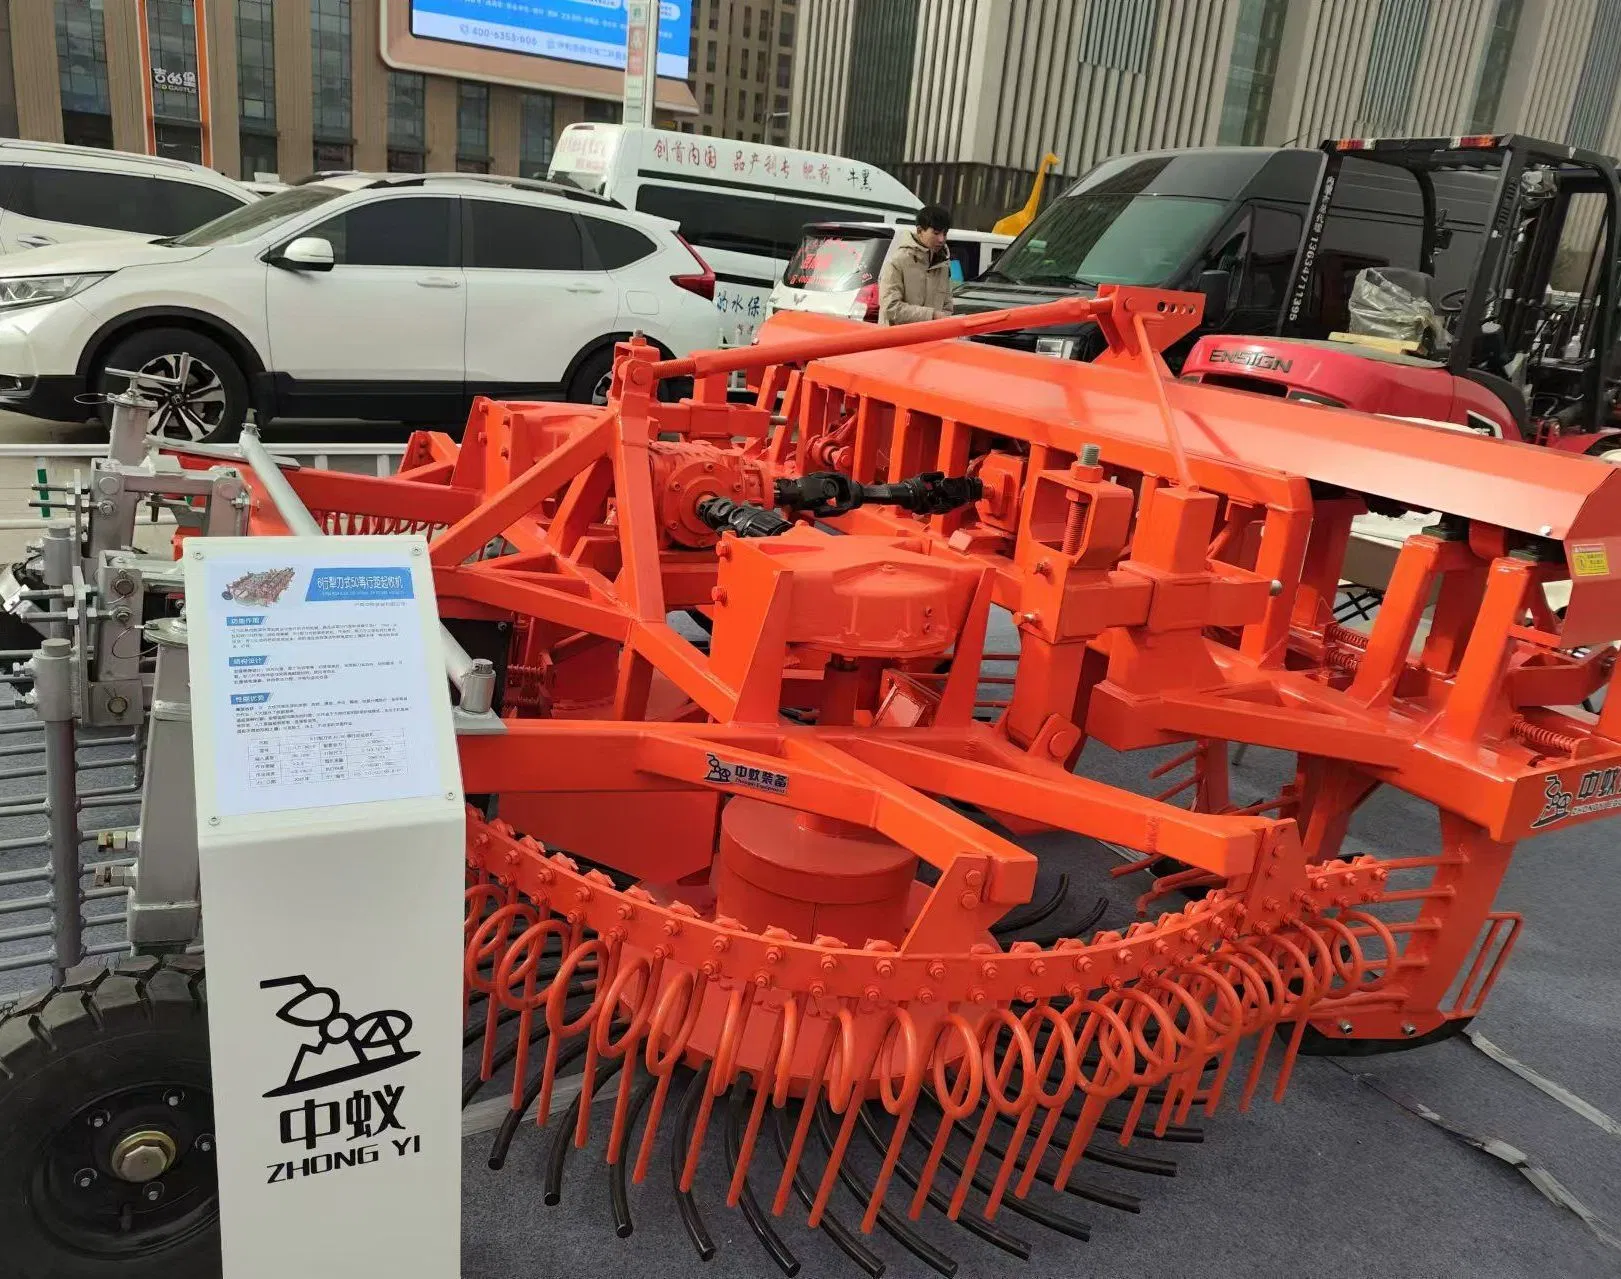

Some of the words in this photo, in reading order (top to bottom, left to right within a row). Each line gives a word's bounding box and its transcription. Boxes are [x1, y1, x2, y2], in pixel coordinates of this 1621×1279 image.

[1209, 349, 1294, 374] ENSIGN
[735, 765, 787, 788] 中蚁装备
[279, 1084, 406, 1150] 中蚁
[266, 1144, 379, 1184] ZHONG
[391, 1135, 421, 1157] YI
